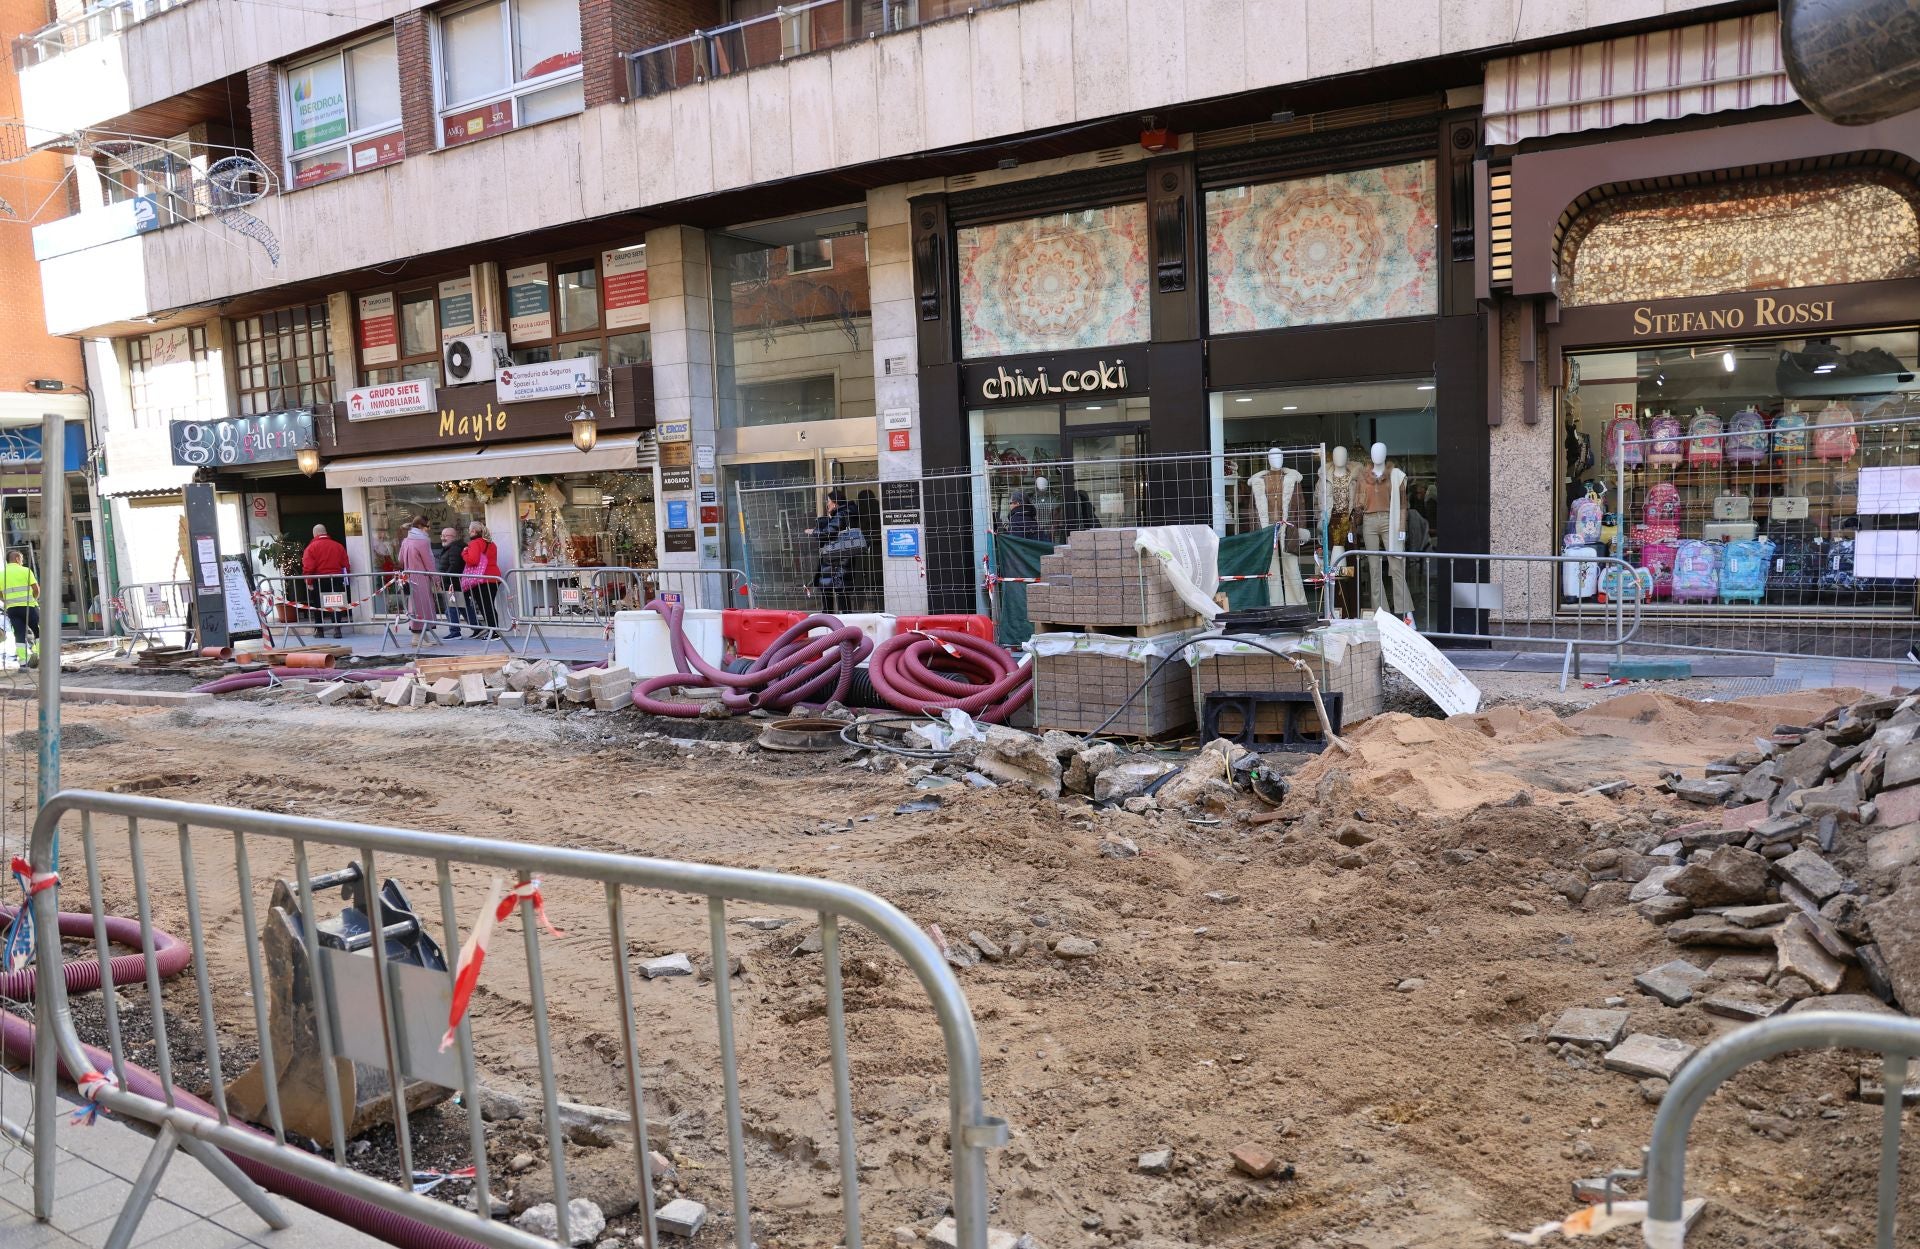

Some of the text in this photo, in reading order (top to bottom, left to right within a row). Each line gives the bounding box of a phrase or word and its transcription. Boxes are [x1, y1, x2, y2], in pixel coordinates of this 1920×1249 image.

[300, 94, 344, 116] IBERDROLA
[541, 369, 549, 377] de
[549, 368, 572, 377] Seguros
[982, 359, 1128, 399] chivi_coki
[369, 384, 420, 399] GRUPO SIETE
[514, 387, 534, 395] AGENCIA
[370, 395, 421, 410] INMOBILIARIA
[439, 403, 507, 442] Mayte
[562, 590, 578, 599] RILO
